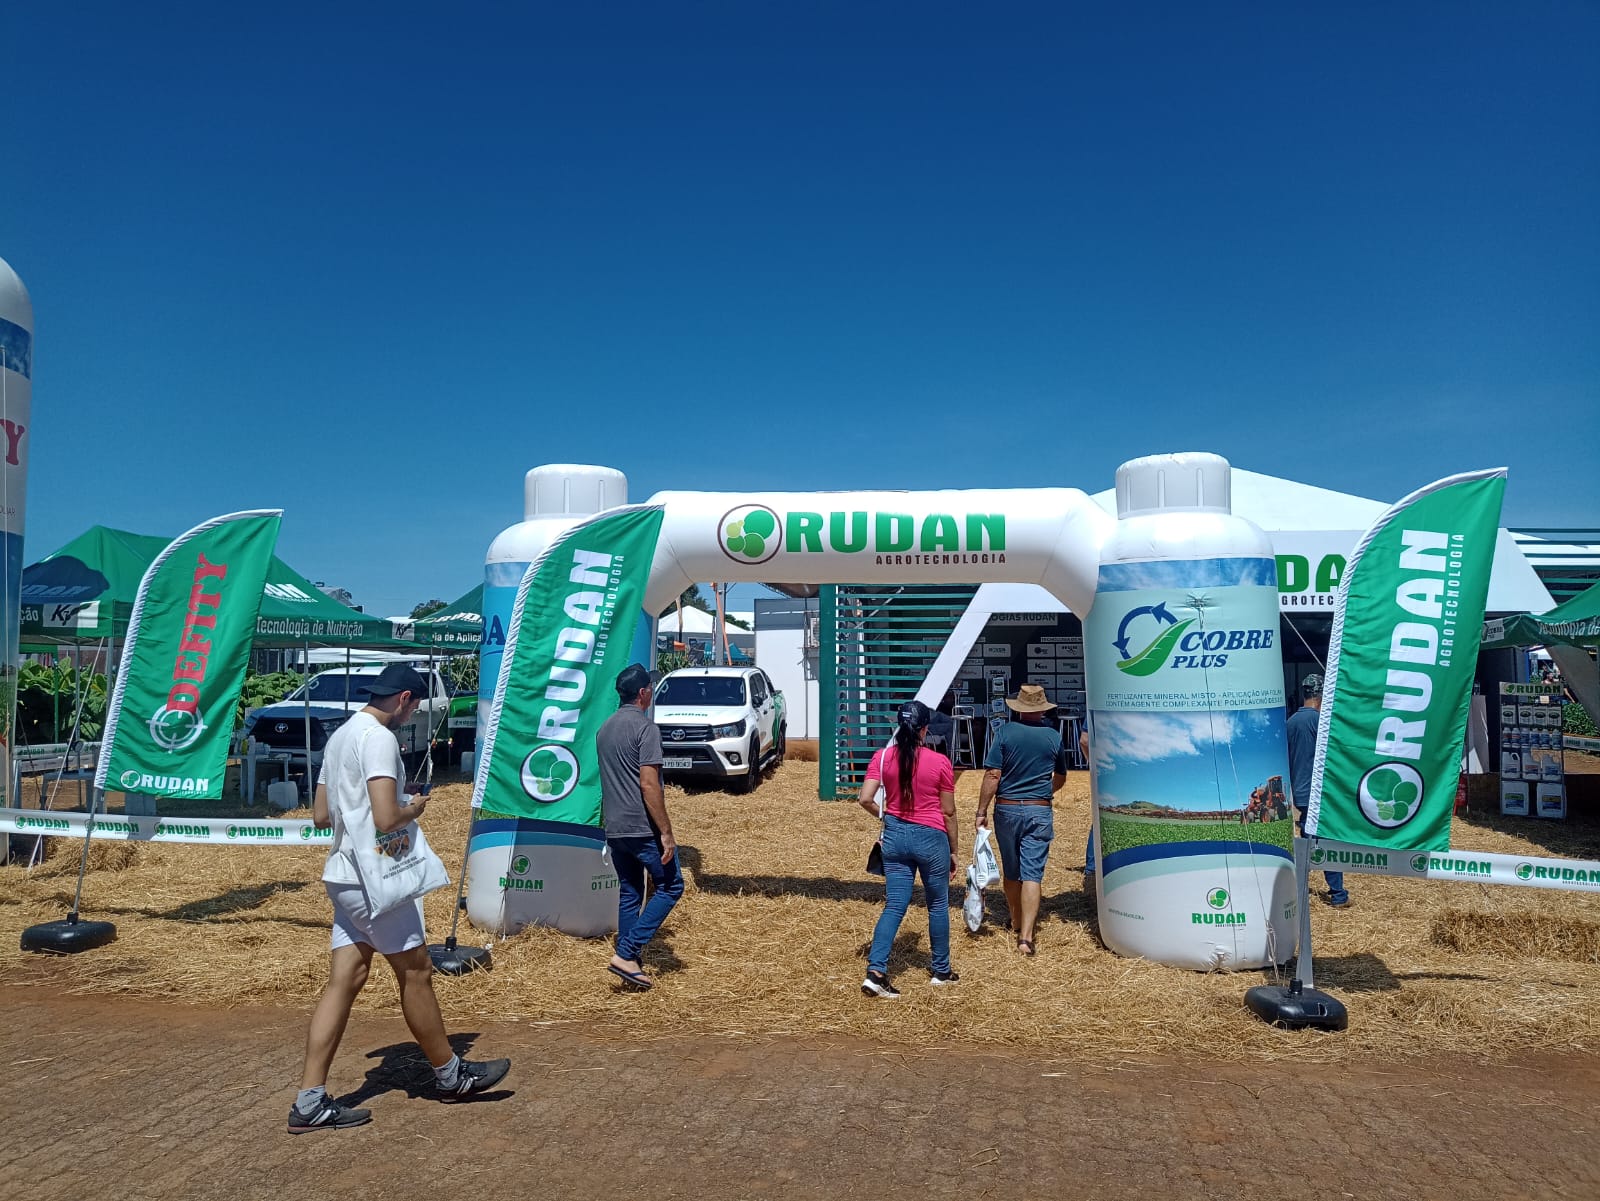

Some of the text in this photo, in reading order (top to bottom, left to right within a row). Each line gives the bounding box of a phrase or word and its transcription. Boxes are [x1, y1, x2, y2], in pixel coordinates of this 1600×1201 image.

[786, 511, 1006, 554] RUDAN
[875, 553, 1006, 566] AGROTECNOLOGIA
[1438, 534, 1464, 667] AGROTECNOLOGIA
[593, 555, 625, 665] AGROTECNOLOGIA
[166, 552, 228, 715] DEFITY
[256, 616, 363, 640] Tecnologia de Nutrição
[456, 632, 483, 644] Aplica
[536, 548, 612, 742] RUDAN
[1180, 629, 1274, 652] COBRE
[1375, 529, 1449, 760] RUDAN
[1170, 654, 1229, 669] PLUS
[1153, 692, 1190, 700] MINERAL
[1516, 685, 1561, 694] RUDAN
[140, 774, 209, 791] RUDAN
[28, 817, 70, 829] RUDAN
[97, 821, 140, 832] RUDAN
[167, 824, 211, 836] RUDAN
[239, 826, 284, 837] RUDAN
[1327, 849, 1388, 866] RUDAN
[1430, 857, 1492, 874] RUDAN
[1535, 865, 1600, 883] RUDAN
[499, 877, 544, 890] RUDAN
[1191, 913, 1246, 924] RUDAN
